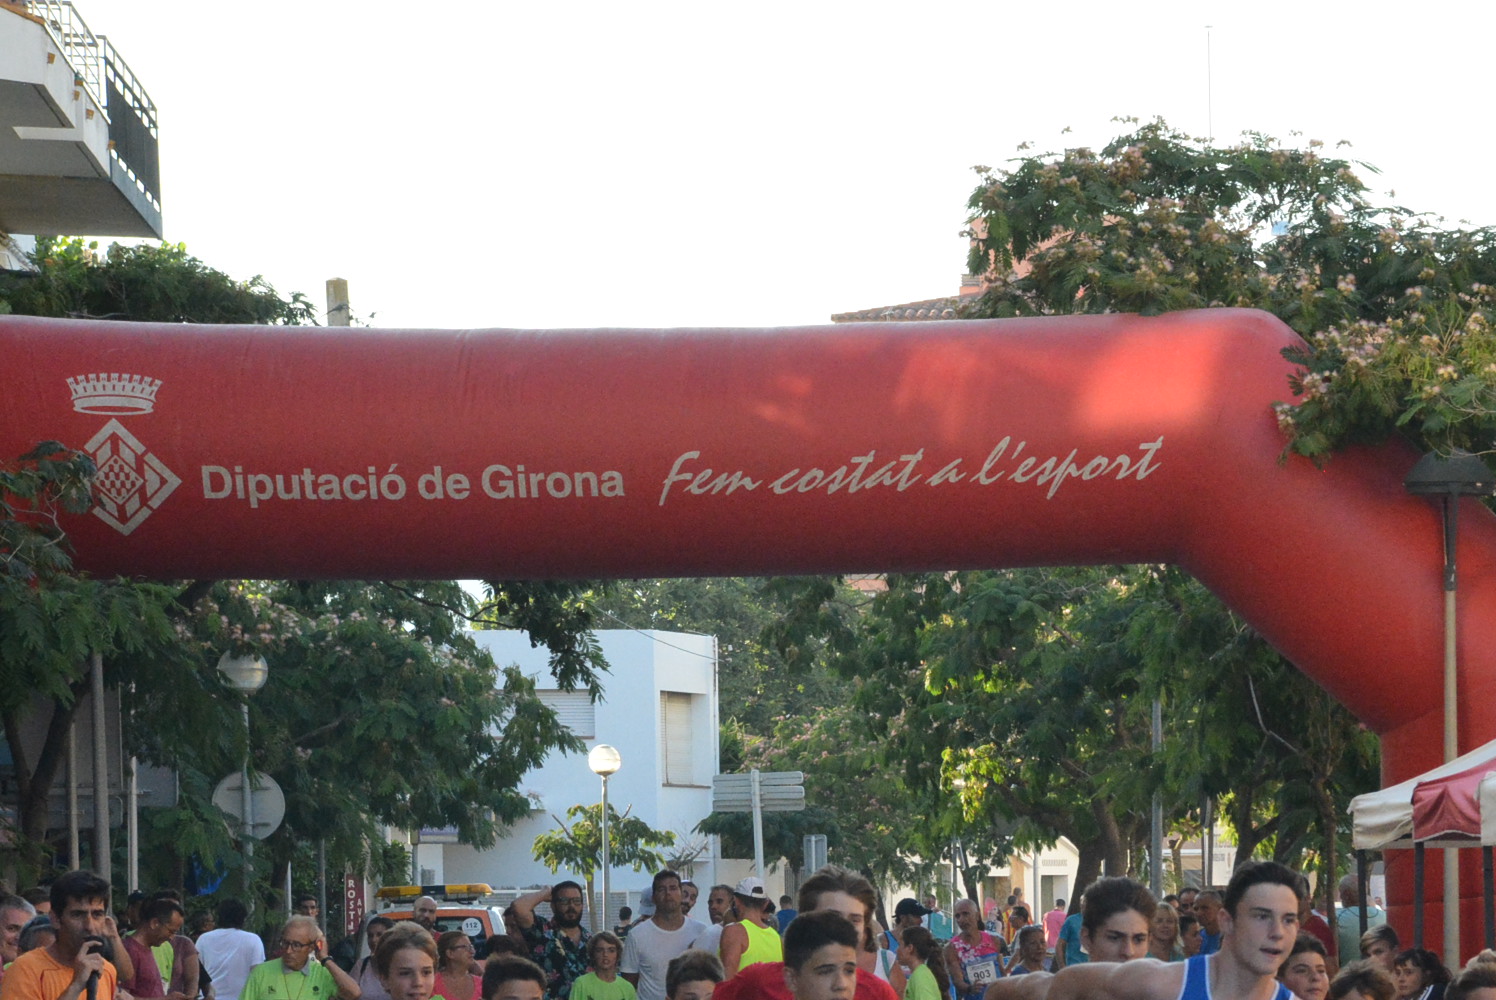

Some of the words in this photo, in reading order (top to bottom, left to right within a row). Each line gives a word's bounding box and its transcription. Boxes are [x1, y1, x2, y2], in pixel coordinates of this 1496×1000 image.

[659, 450, 762, 506] Fem
[768, 447, 924, 494] costat
[925, 458, 966, 488] a
[969, 435, 1165, 500] l'esport
[201, 463, 407, 509] Diputació
[417, 465, 470, 500] de
[481, 464, 625, 500] Girona
[465, 921, 478, 929] 112
[973, 969, 991, 980] 903
